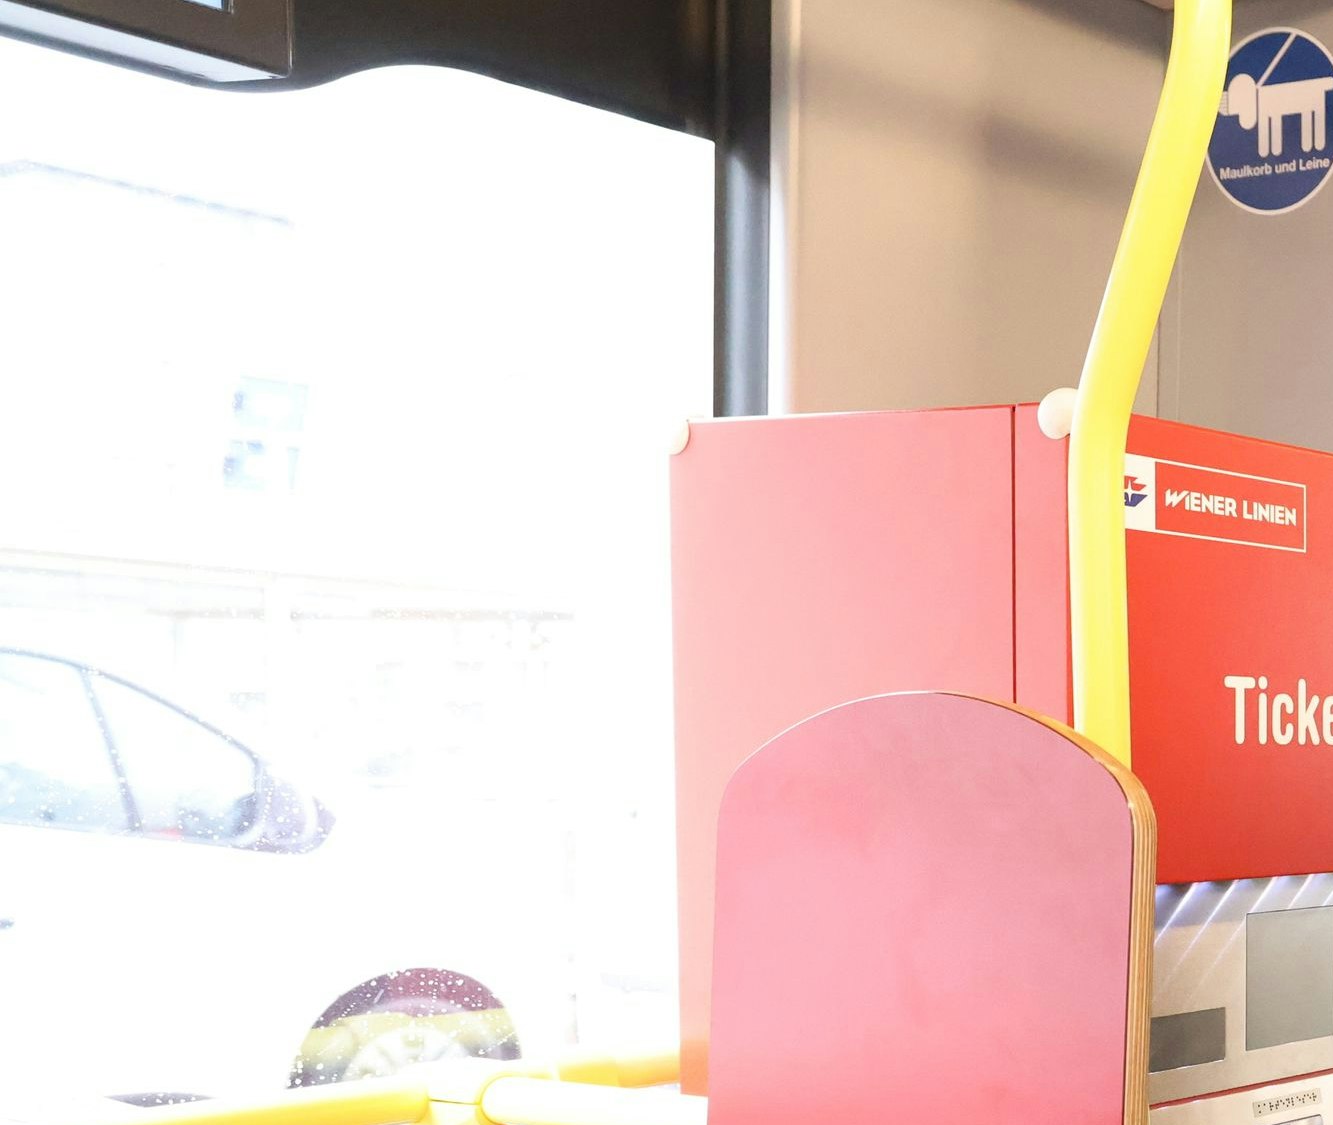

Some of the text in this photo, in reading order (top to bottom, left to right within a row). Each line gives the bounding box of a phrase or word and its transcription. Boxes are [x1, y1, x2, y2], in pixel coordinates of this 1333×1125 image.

[1219, 158, 1330, 180] Maulkorb und Leine
[1242, 500, 1297, 527] LINIEN
